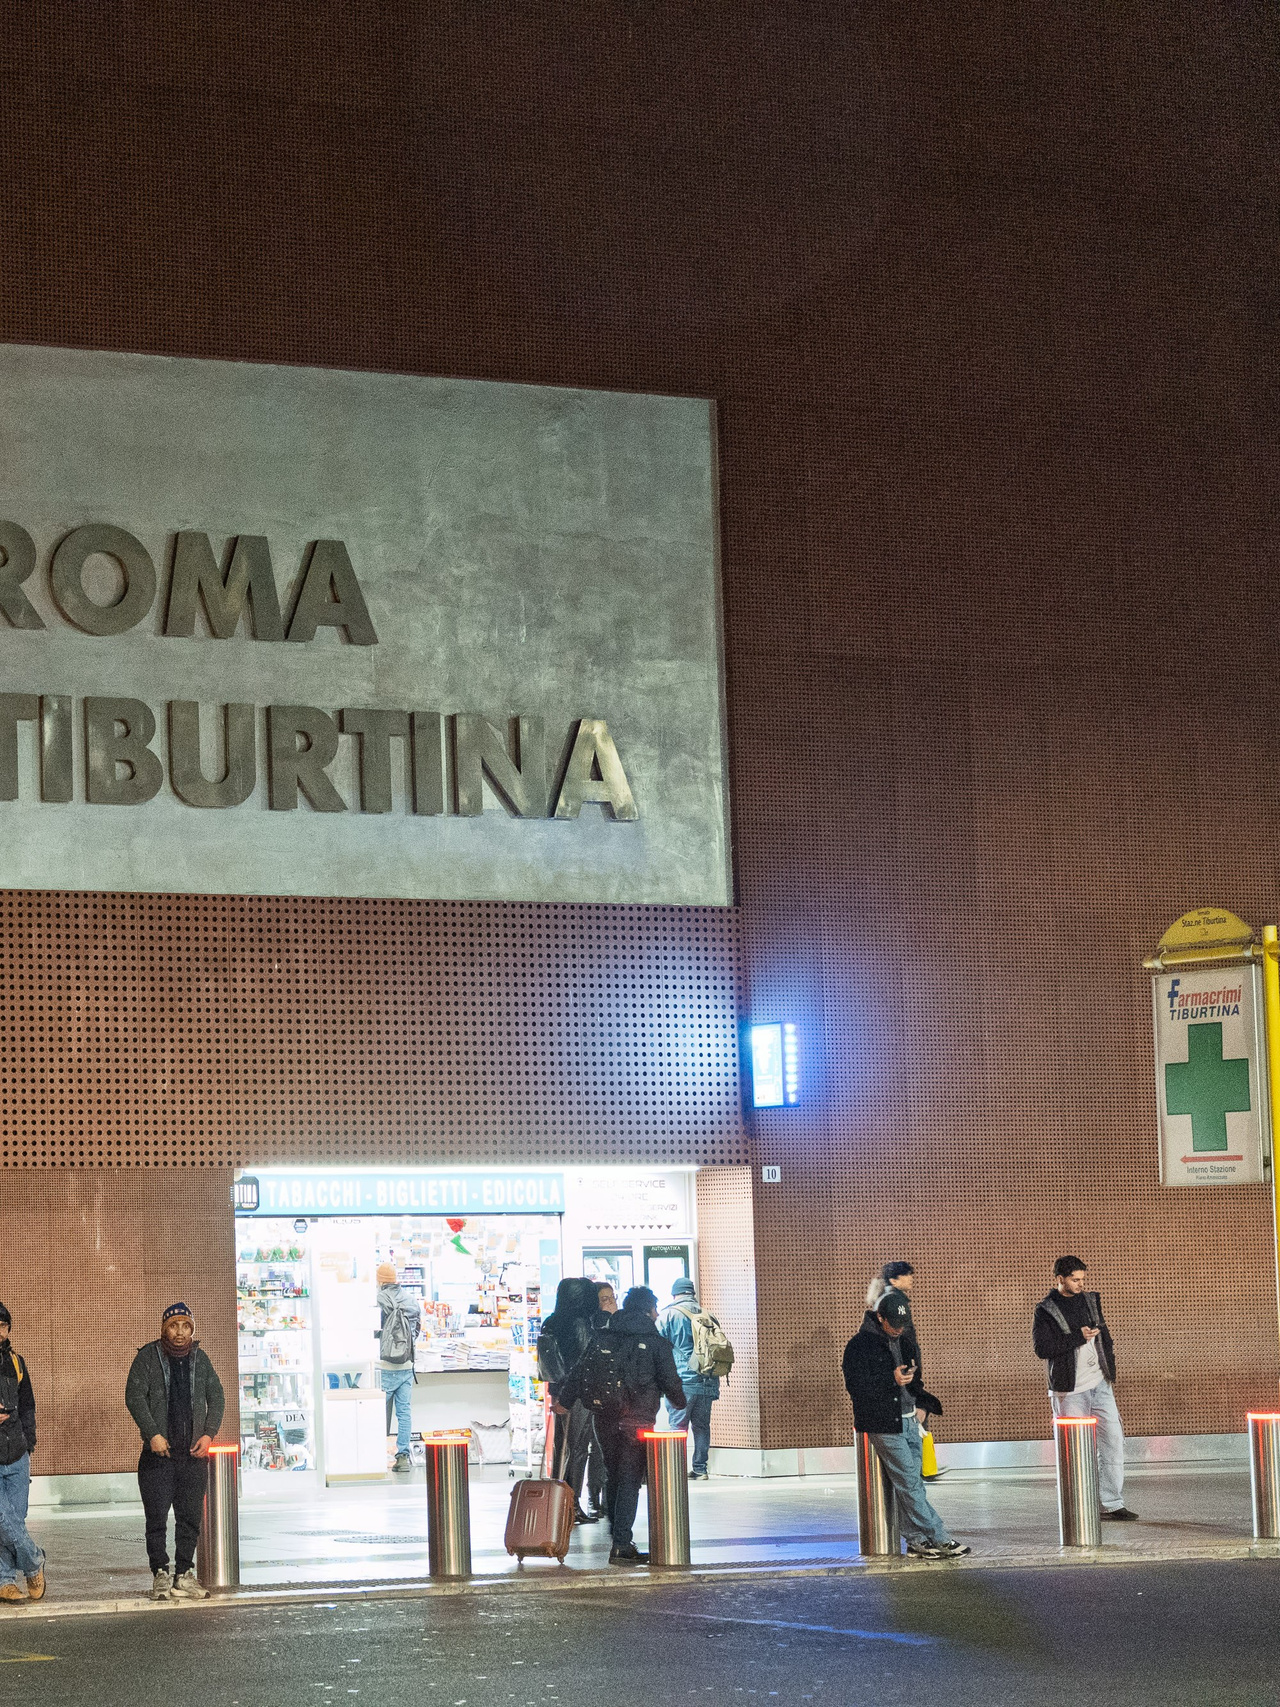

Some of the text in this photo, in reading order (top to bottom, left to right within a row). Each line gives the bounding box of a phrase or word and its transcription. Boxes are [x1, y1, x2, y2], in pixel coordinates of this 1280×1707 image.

[1202, 916, 1227, 925] Tiburtina
[1170, 1004, 1240, 1020] TIBURTINA
[1210, 1165, 1236, 1173] Stazione
[766, 1168, 776, 1180] 10
[622, 1180, 666, 1188] SERVICE
[266, 1180, 361, 1207] TABACCHI
[376, 1180, 468, 1207] BIGLIETTI
[482, 1179, 561, 1206] EDICOLA
[286, 1414, 306, 1422] DEA
